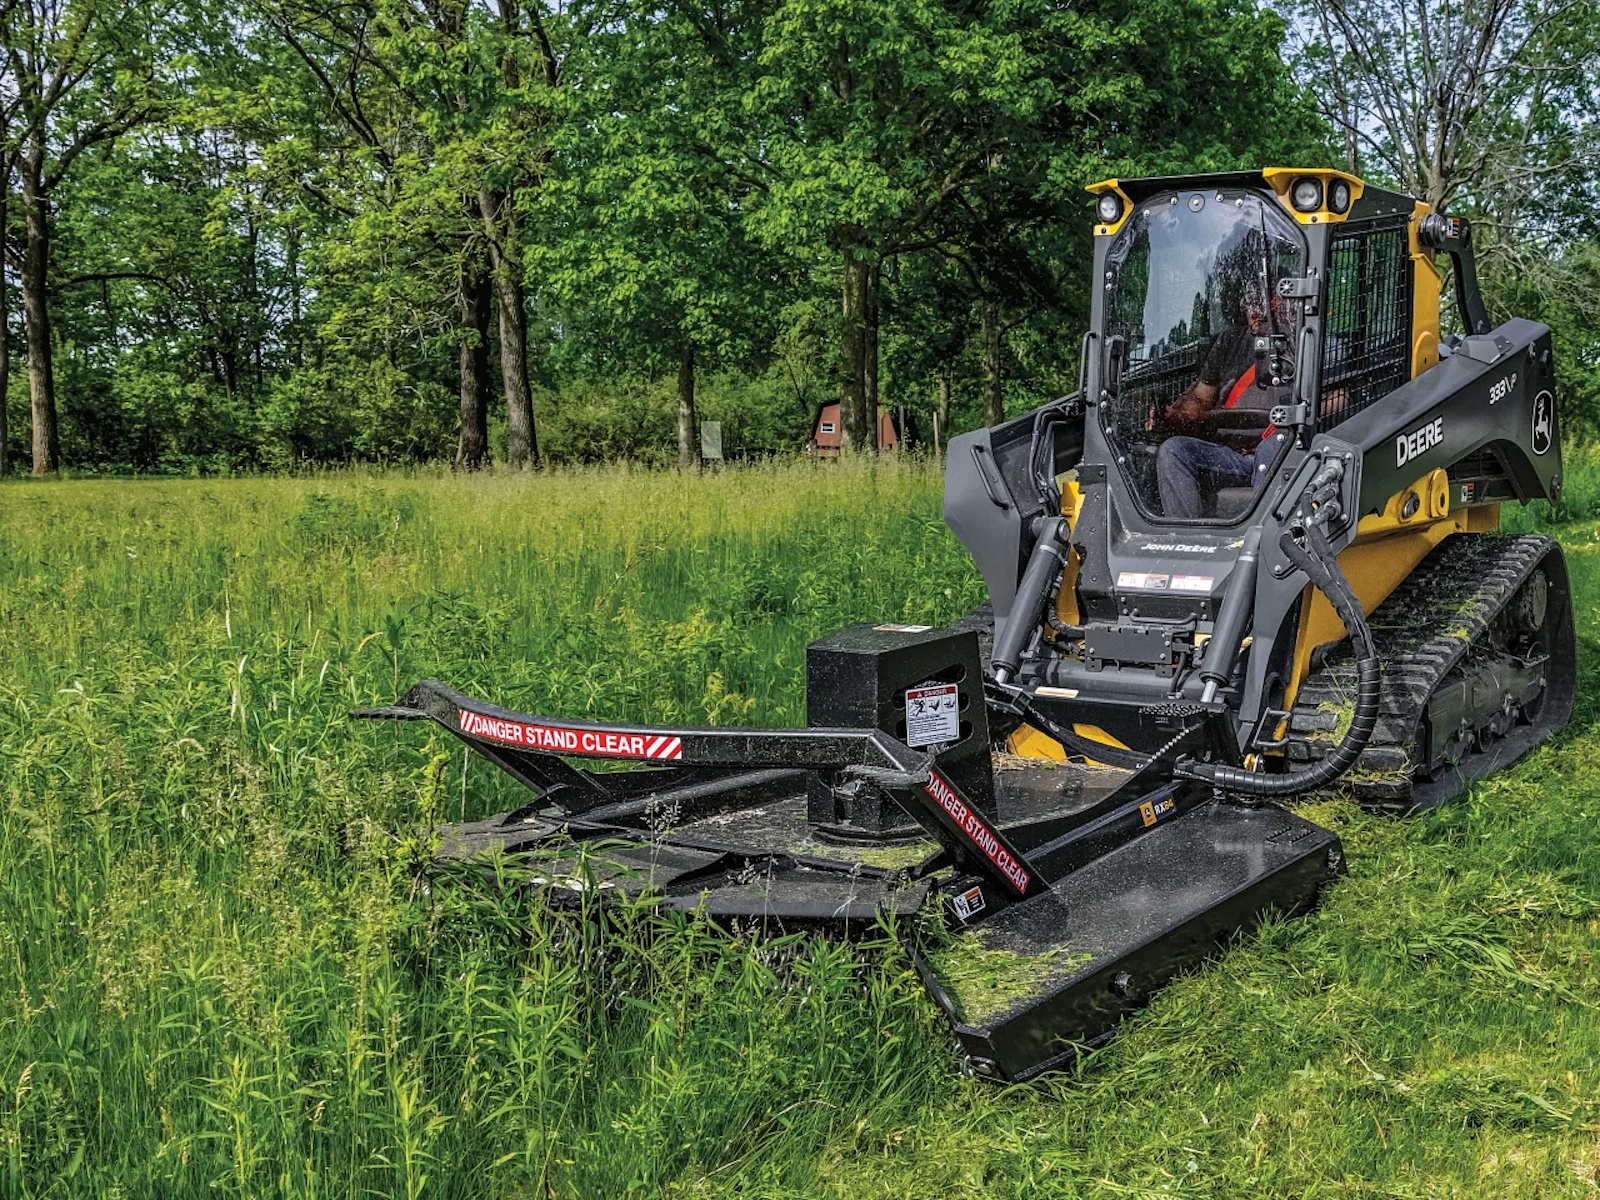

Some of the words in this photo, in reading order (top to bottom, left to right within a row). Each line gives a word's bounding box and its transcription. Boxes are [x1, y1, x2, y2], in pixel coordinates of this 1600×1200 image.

[1397, 416, 1443, 468] DEERE
[1141, 543, 1174, 551] JOHN
[1175, 544, 1217, 553] DEERE
[474, 717, 523, 742] DANGER
[526, 728, 577, 749] STAND
[582, 735, 644, 754] CLEAR
[965, 816, 999, 857] STAND
[997, 851, 1028, 890] CLEAR
